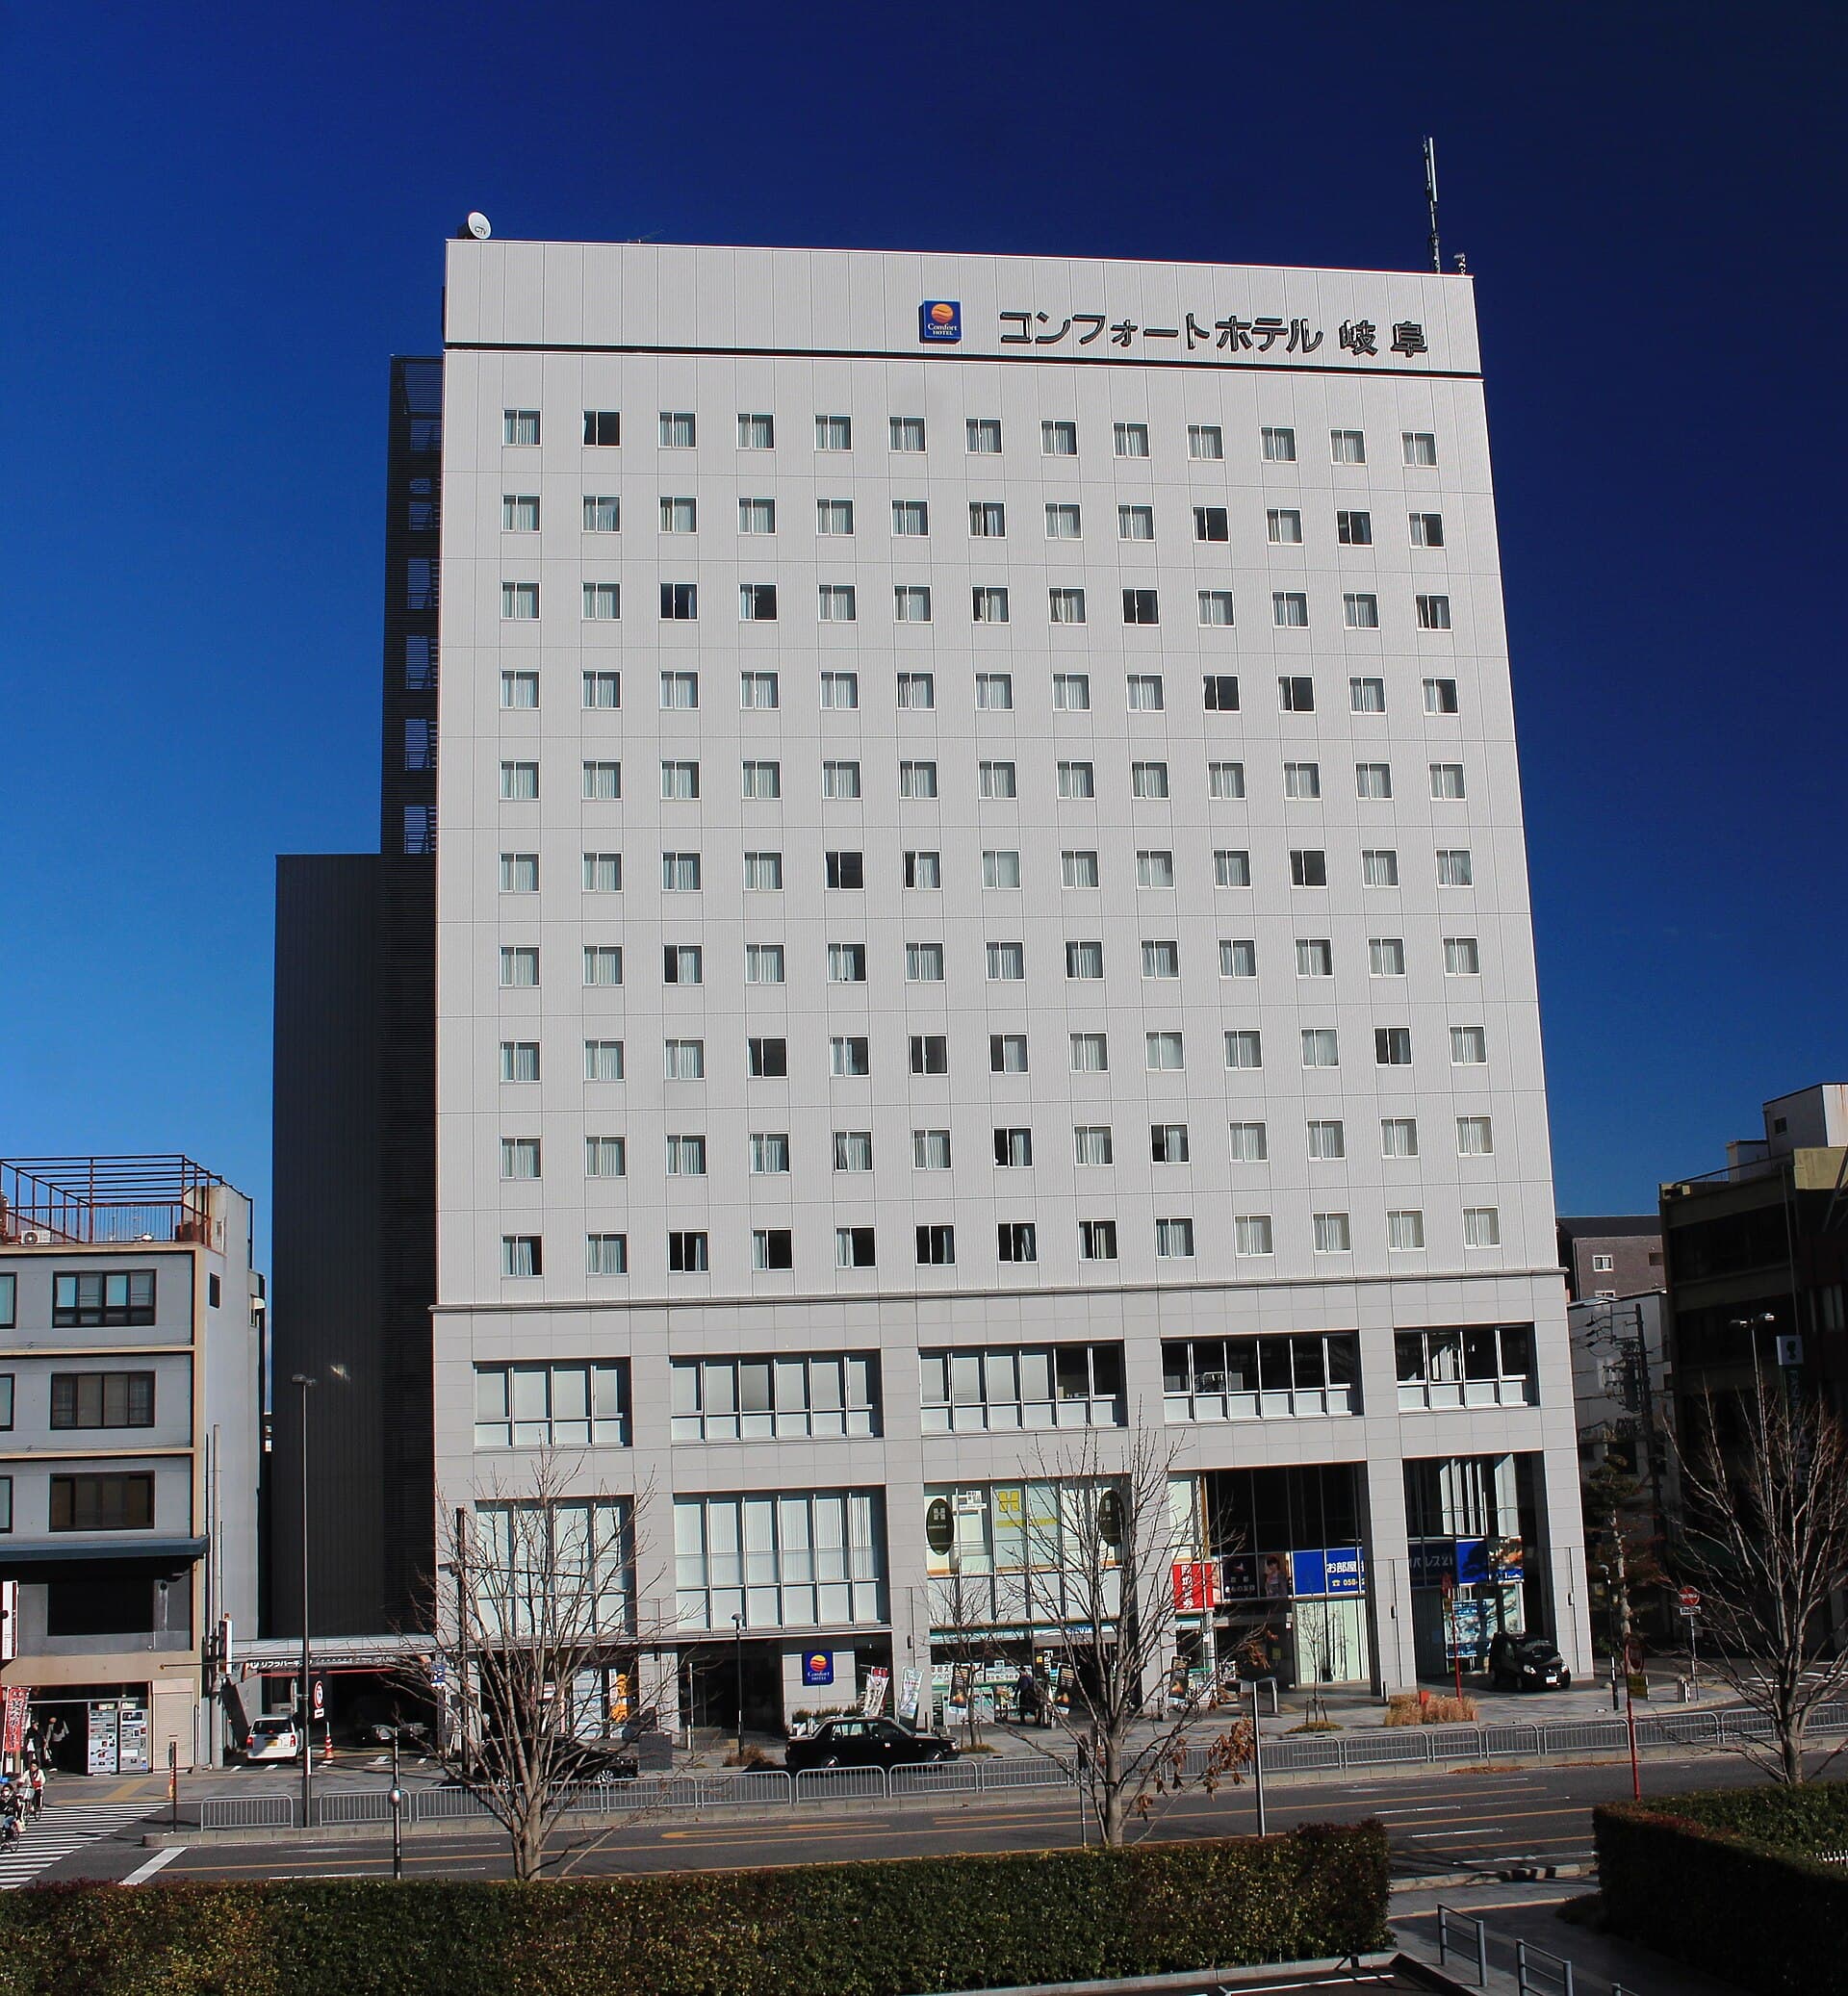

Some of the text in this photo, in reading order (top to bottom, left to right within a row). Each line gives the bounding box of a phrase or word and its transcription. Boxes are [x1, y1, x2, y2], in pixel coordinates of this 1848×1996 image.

[927, 322, 958, 331] Comfort
[999, 311, 1428, 357] コンフォートホテル岐阜
[1409, 1554, 1453, 1569] パレス21
